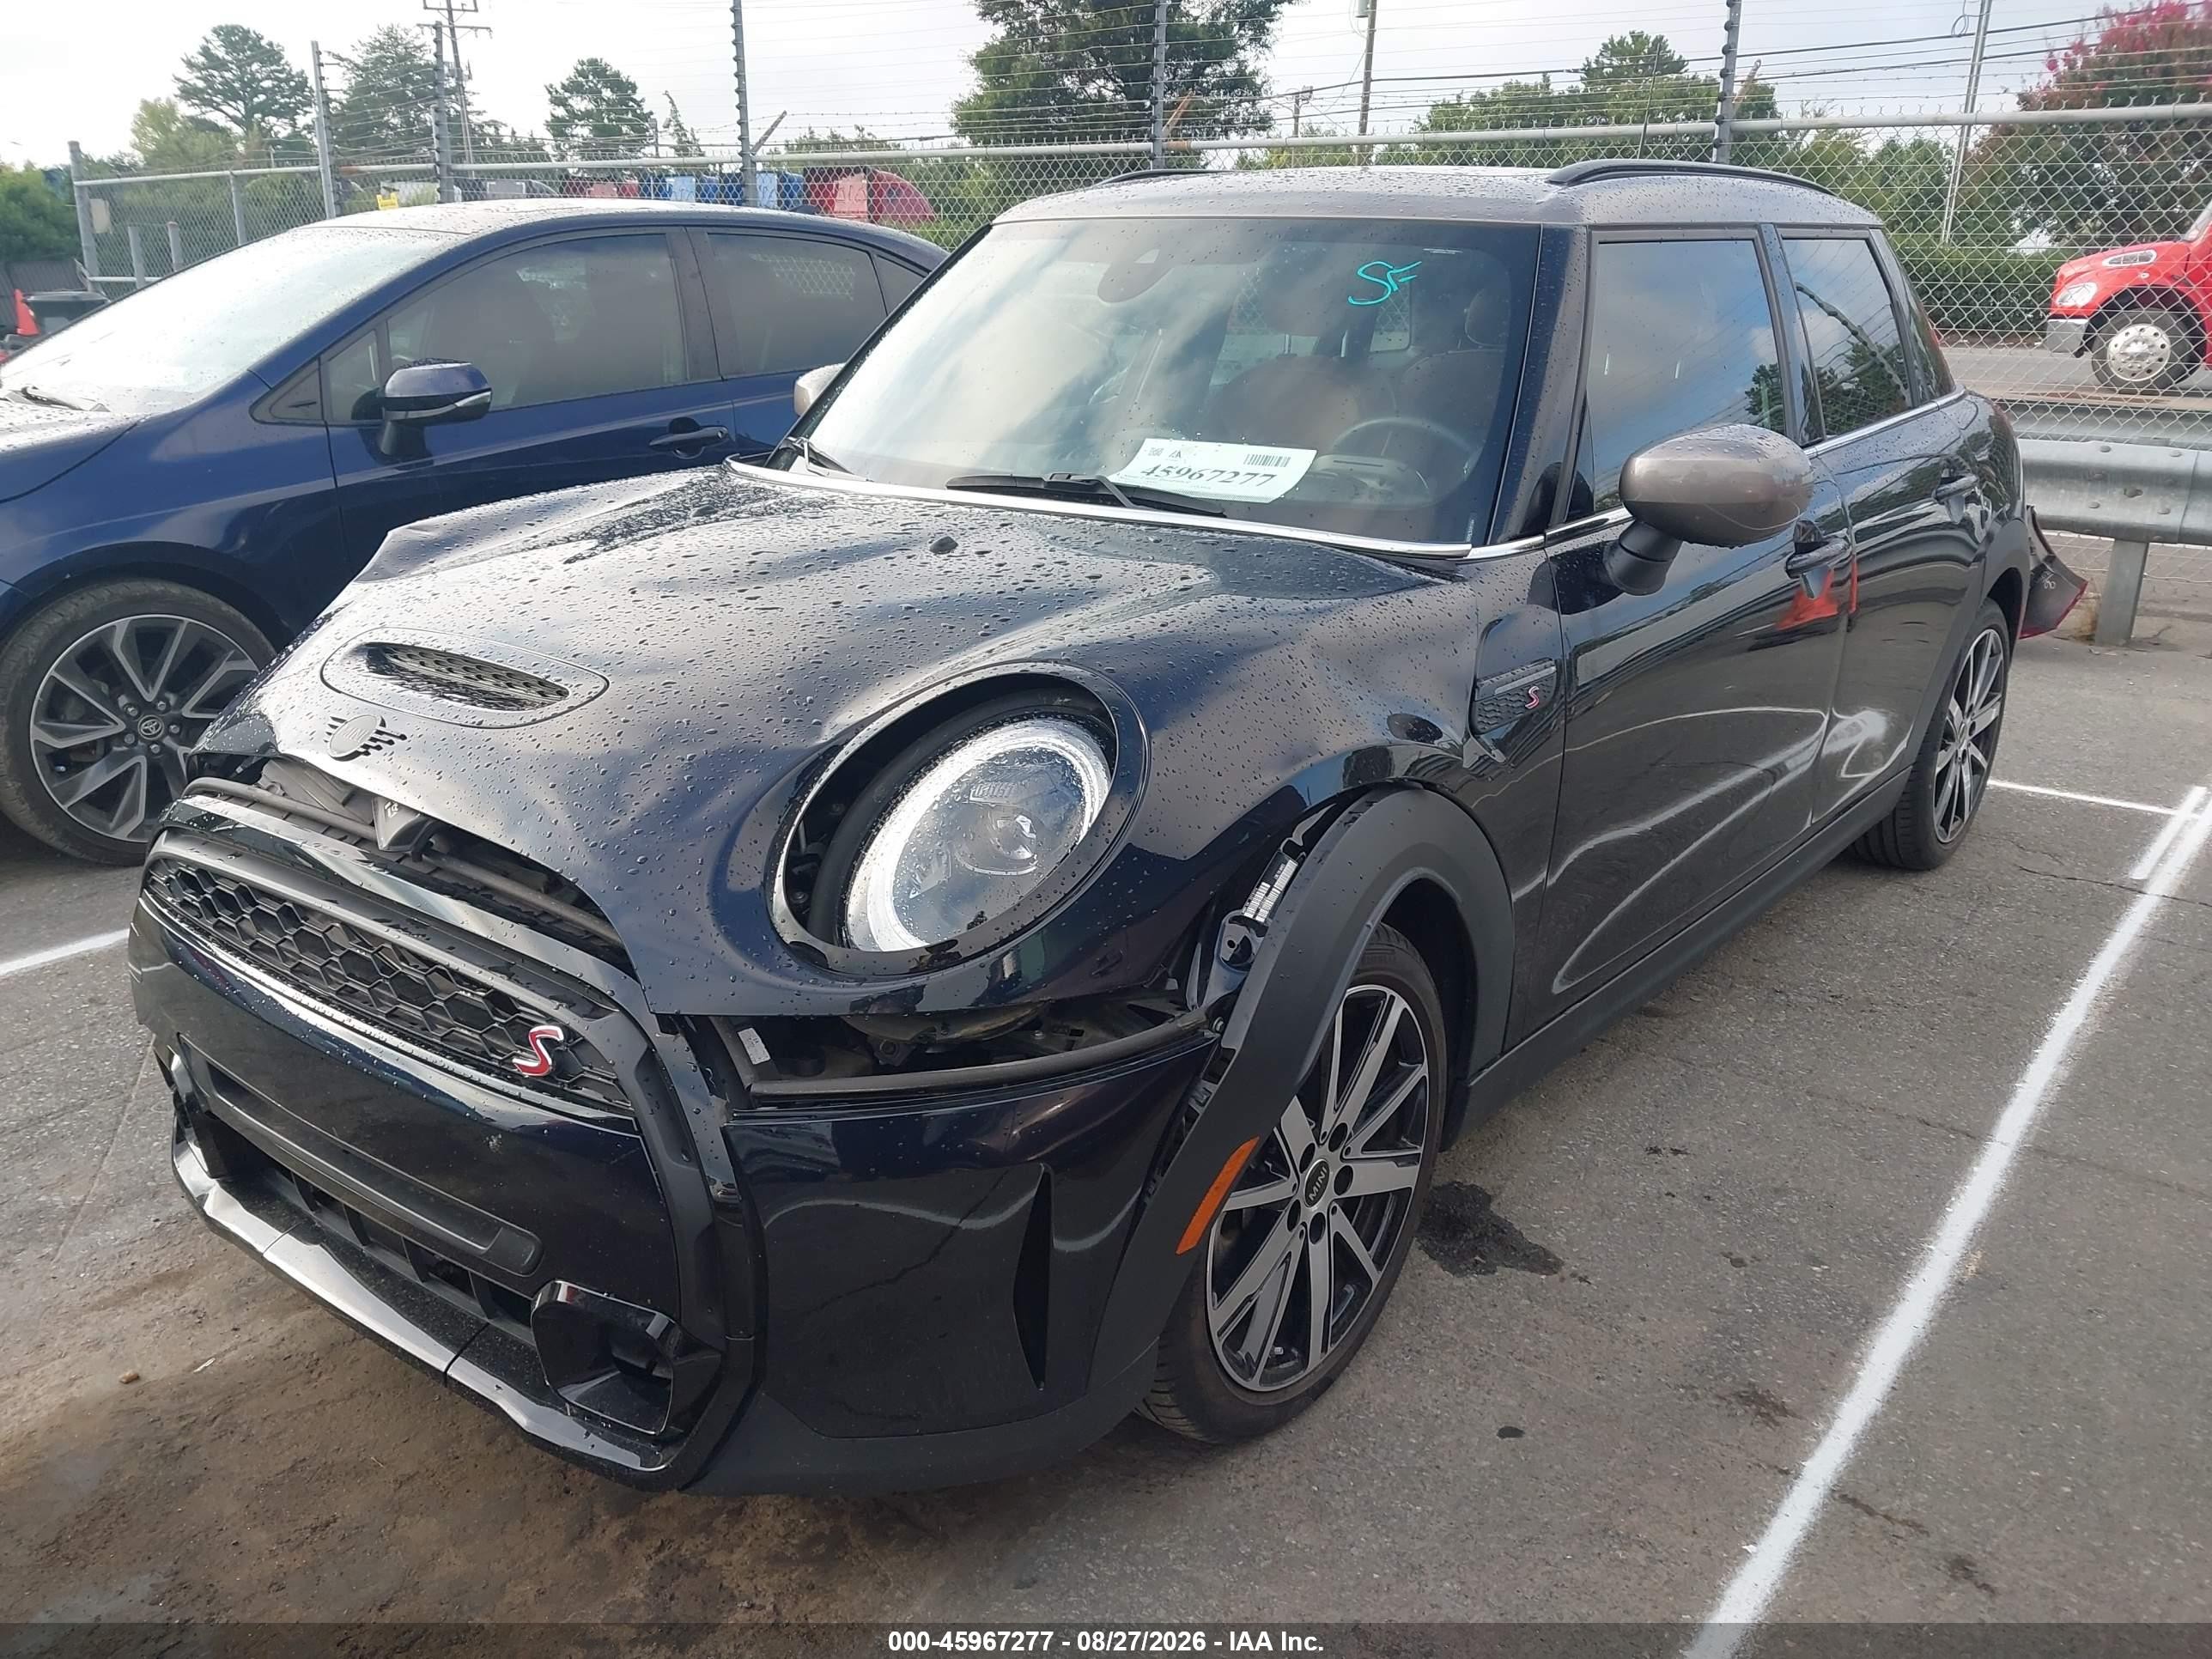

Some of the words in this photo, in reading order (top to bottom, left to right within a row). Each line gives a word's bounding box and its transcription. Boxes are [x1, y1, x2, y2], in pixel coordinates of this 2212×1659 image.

[1140, 464, 1278, 487] 45967277
[1524, 685, 1540, 709] S
[512, 1024, 564, 1077] S
[1308, 1166, 1328, 1201] MINI
